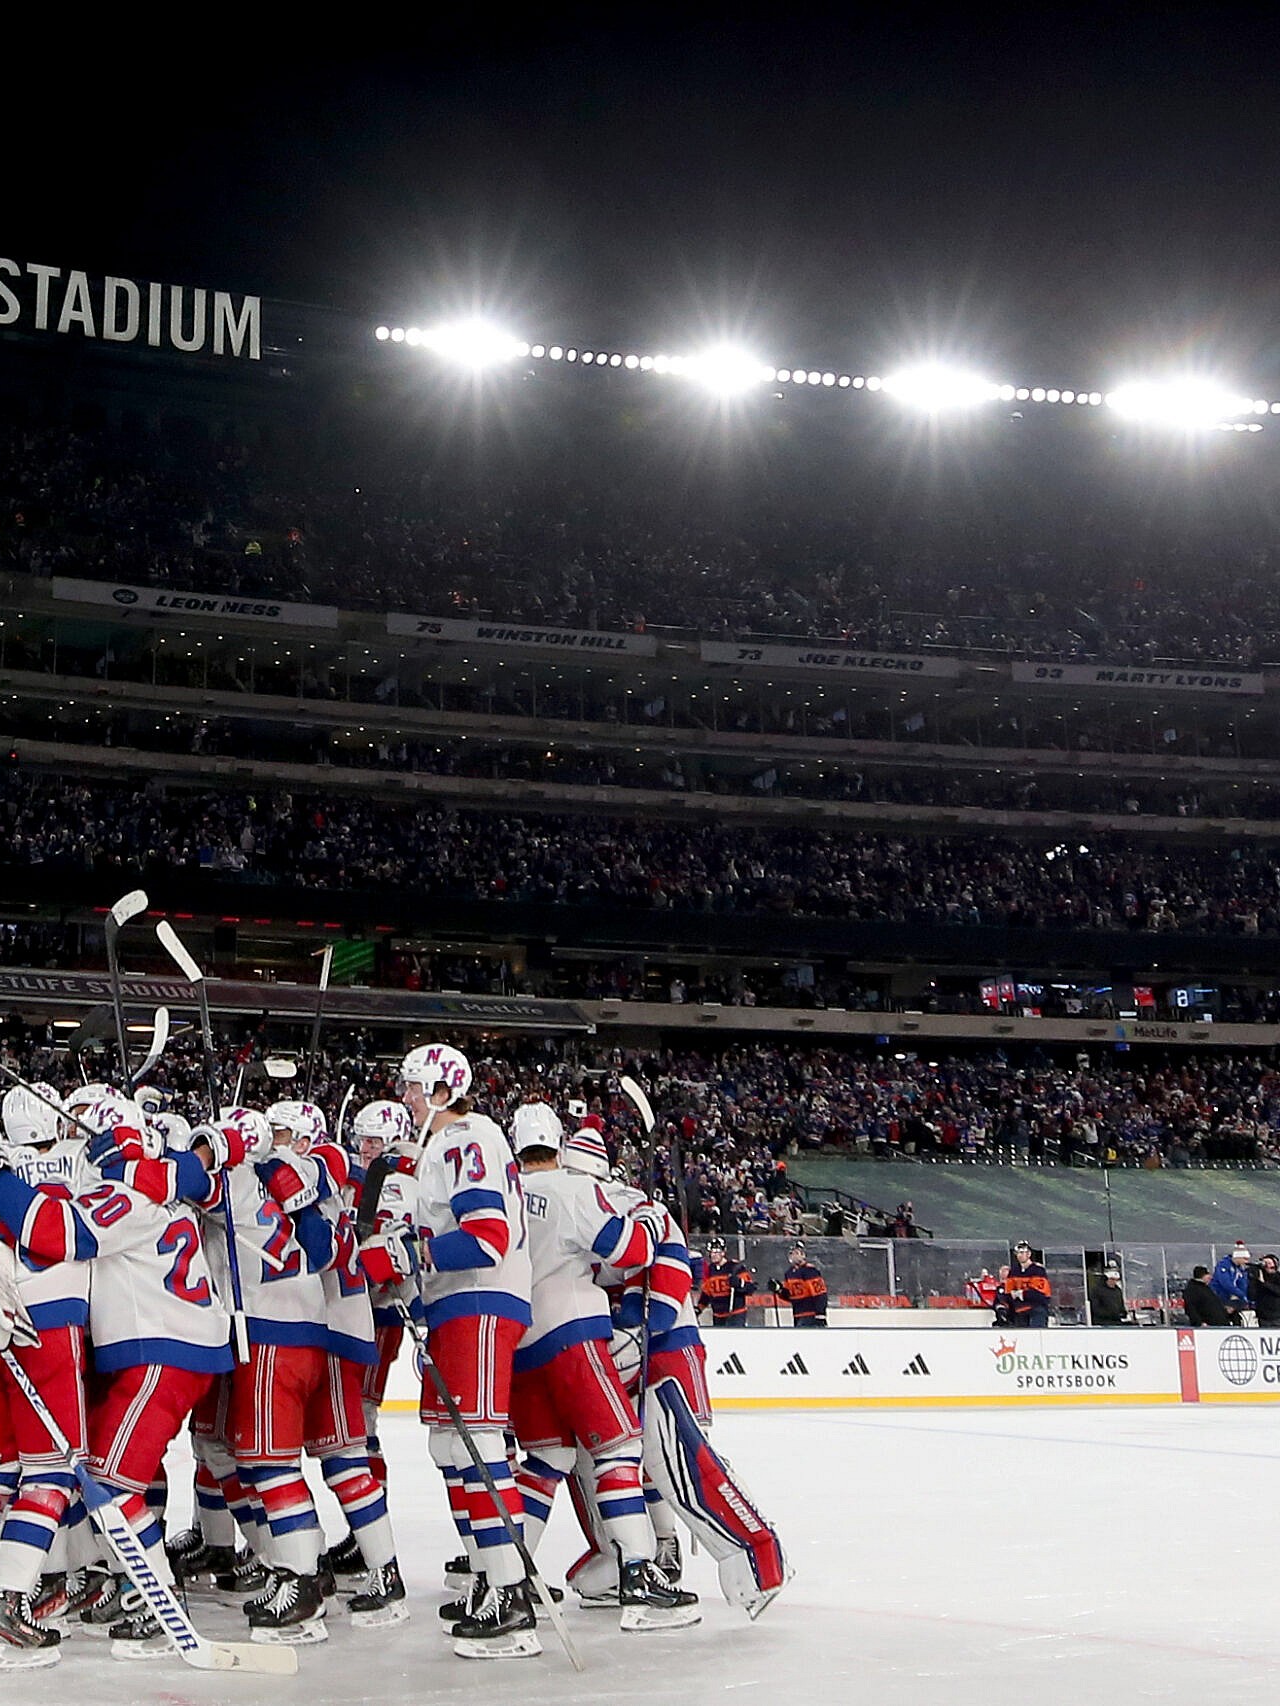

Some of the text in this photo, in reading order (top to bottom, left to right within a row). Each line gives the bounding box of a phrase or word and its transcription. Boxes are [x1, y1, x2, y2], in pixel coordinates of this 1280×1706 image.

[156, 595, 218, 612] LEON
[477, 627, 577, 647] WINSTON
[580, 636, 628, 649] HILL
[798, 653, 841, 666] JOE
[1096, 671, 1173, 685] MARTY
[1175, 675, 1243, 689] LYONS
[86, 981, 199, 999] STADIUM
[1134, 1025, 1178, 1039] MetLife
[444, 1142, 486, 1188] 73
[78, 1184, 133, 1229] 20
[996, 1354, 1129, 1374] DRAFTKINGS
[1017, 1375, 1117, 1388] SPORTSBOOK
[717, 1482, 763, 1534] VAUGHN
[108, 1527, 200, 1653] WARRIOR
